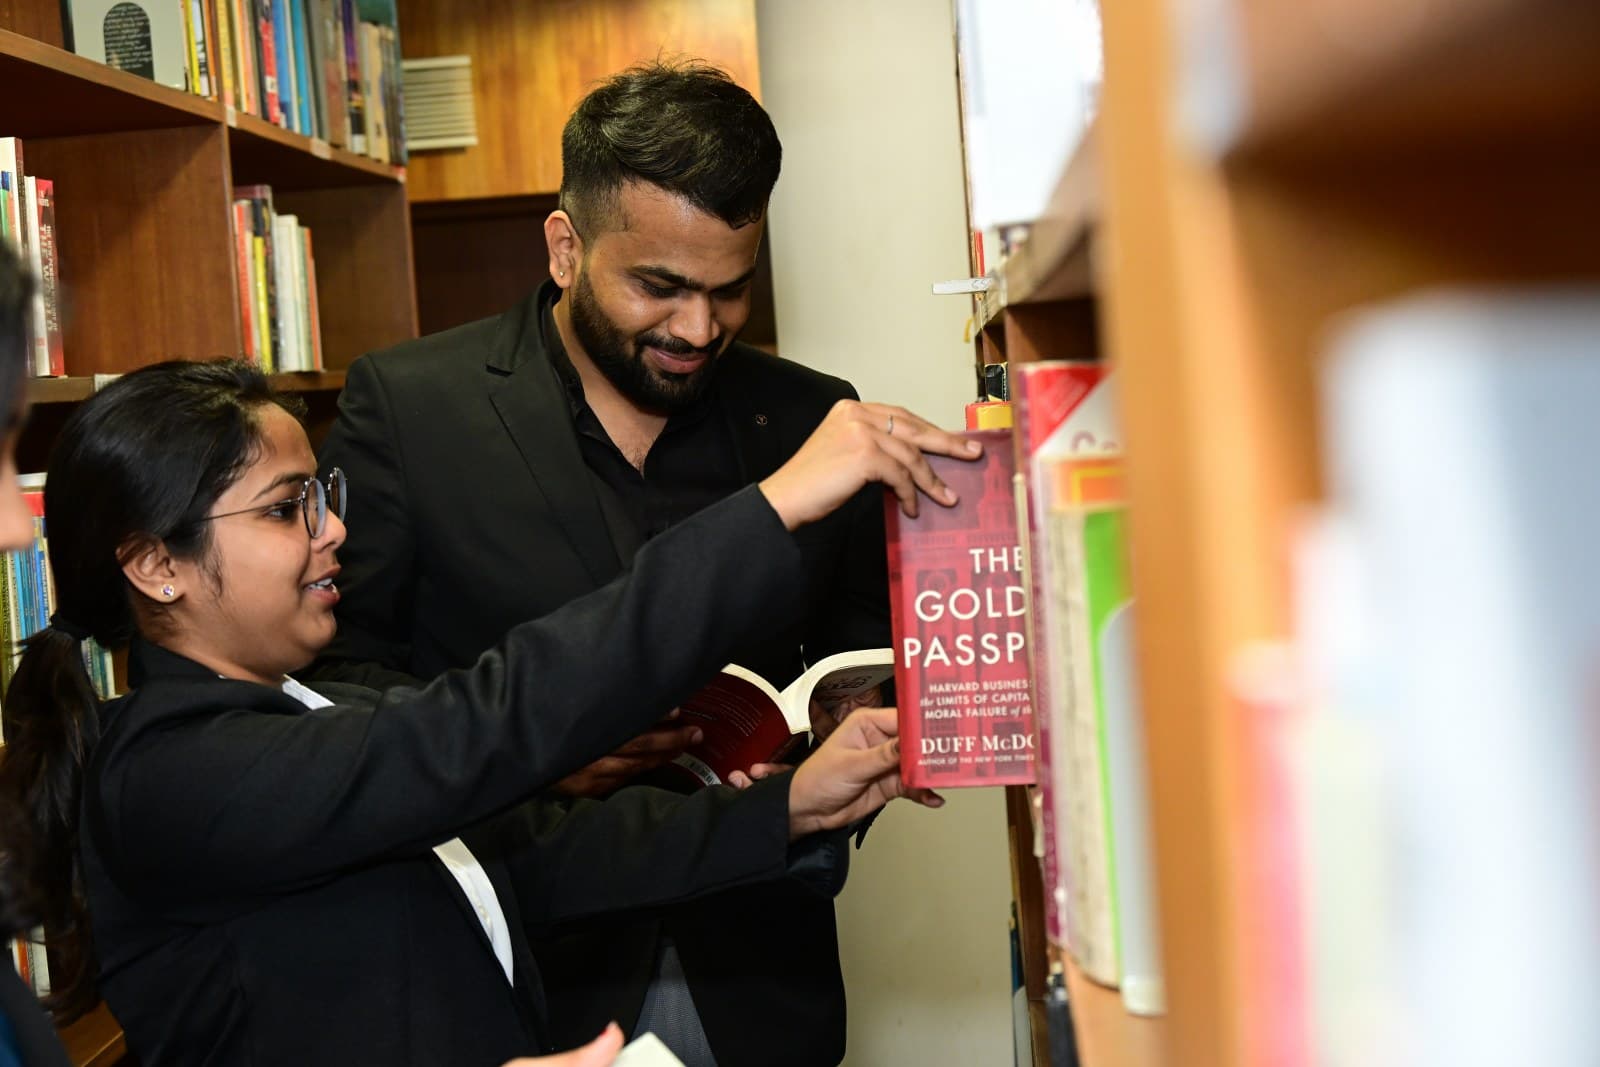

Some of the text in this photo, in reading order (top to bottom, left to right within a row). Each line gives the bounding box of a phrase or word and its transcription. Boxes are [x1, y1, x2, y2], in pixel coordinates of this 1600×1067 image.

[968, 546, 1023, 574] THE
[914, 585, 1026, 622] GOLD
[903, 632, 1025, 669] PASSP
[929, 681, 979, 693] HARVARD
[920, 692, 1030, 707] the LIMITS OF CAPITA
[924, 707, 962, 719] MORAL
[965, 705, 1007, 717] FAILURE
[1010, 705, 1020, 718] of
[920, 736, 976, 755] DUFF
[918, 757, 946, 766] AUTHOR
[947, 757, 957, 765] OF
[960, 756, 972, 764] THE
[974, 755, 992, 763] NEW
[994, 754, 1012, 762] YORK
